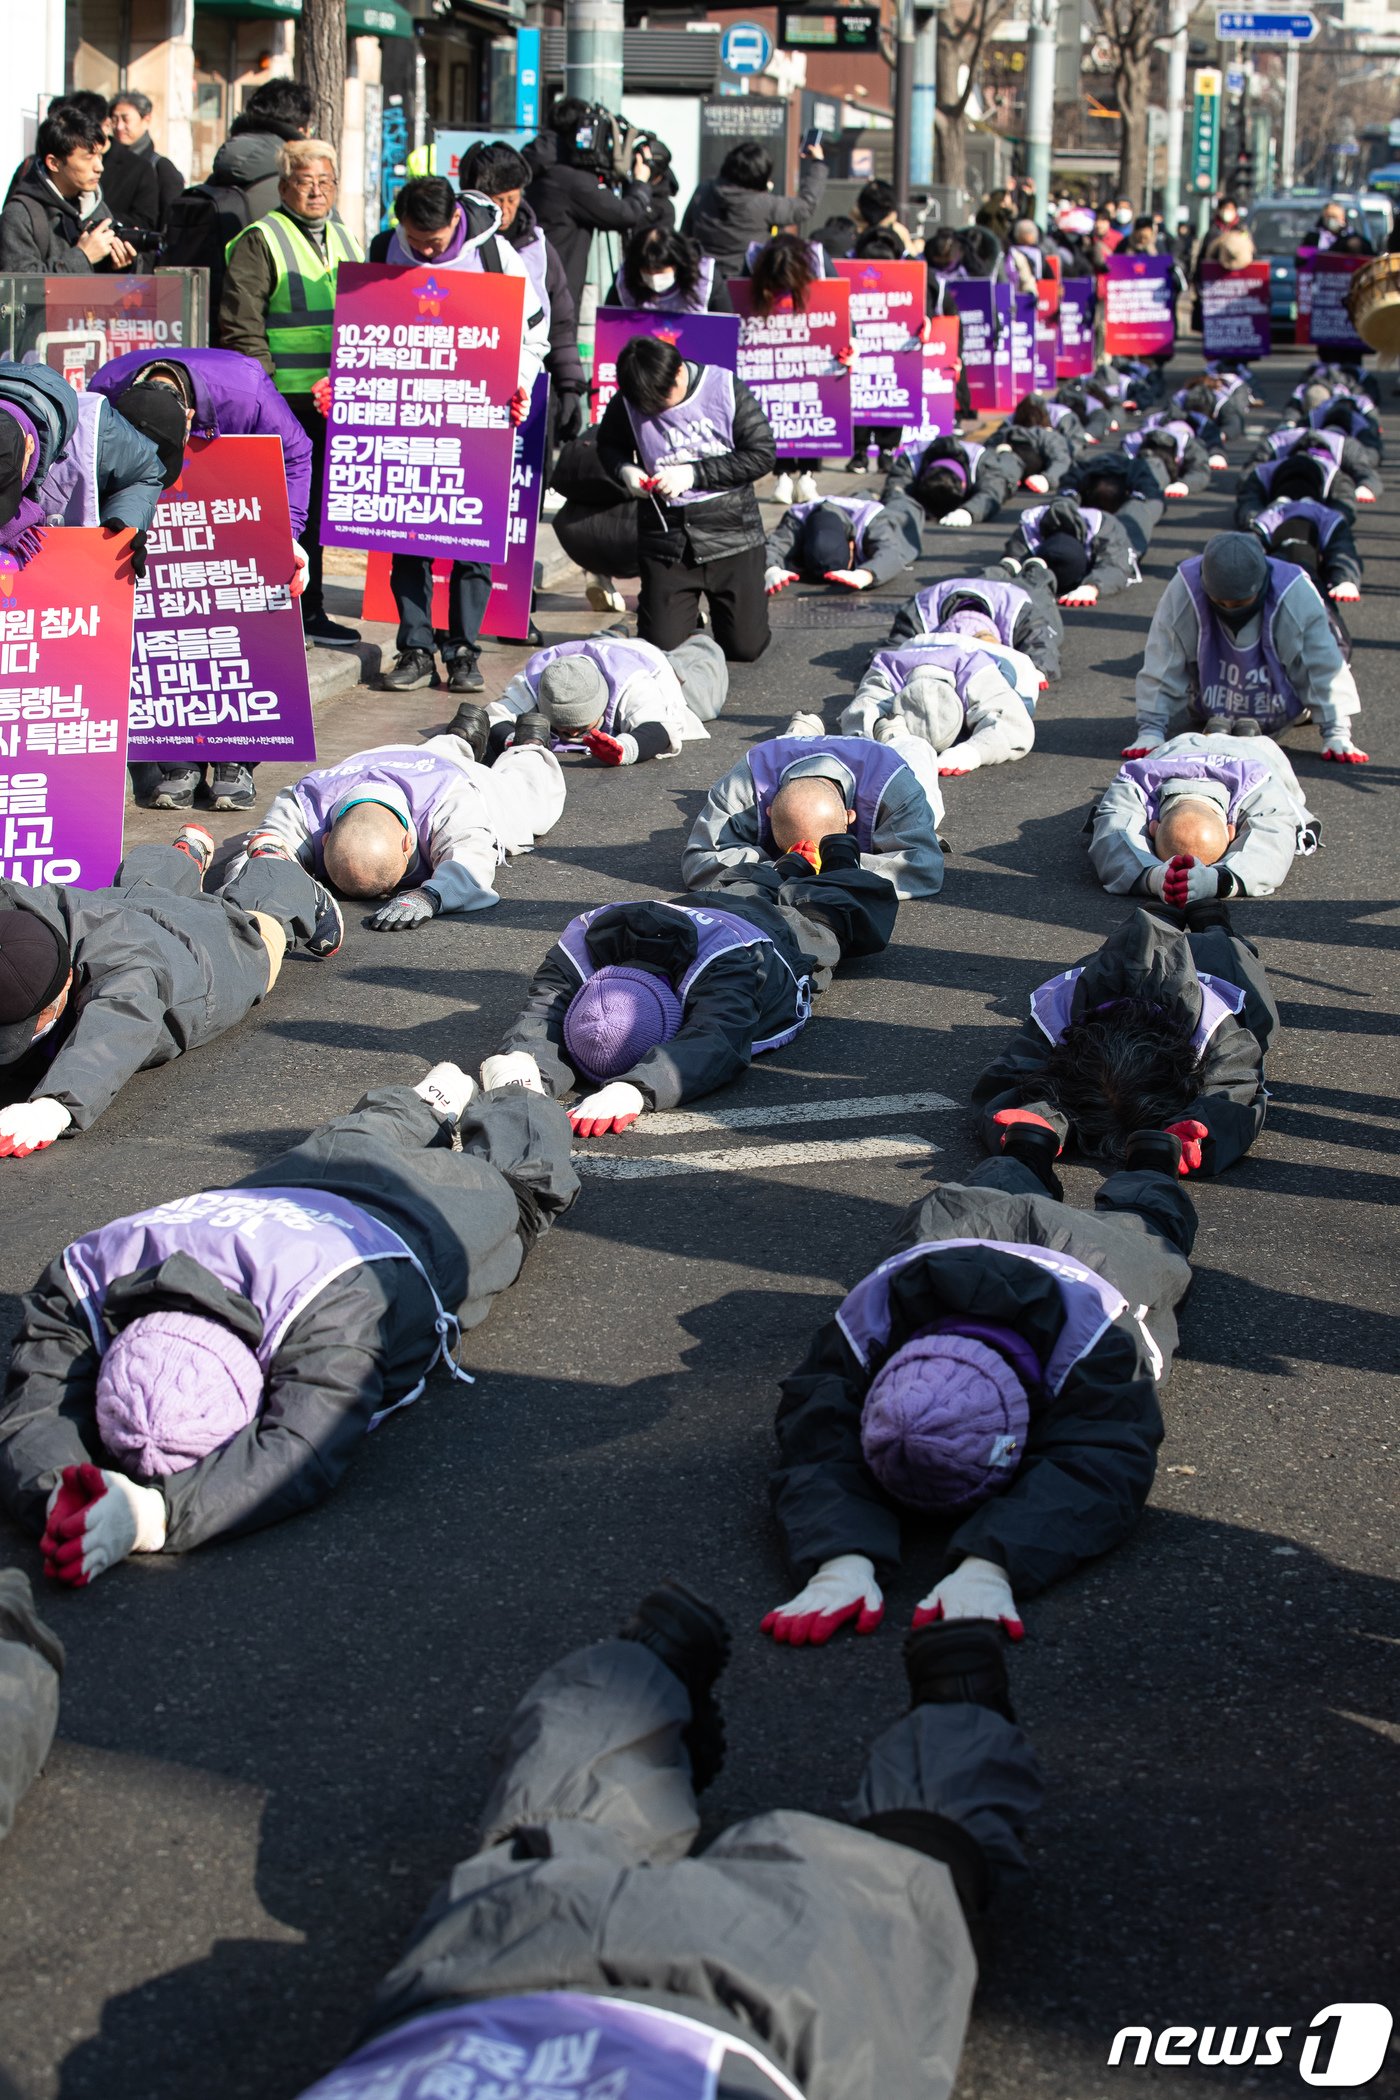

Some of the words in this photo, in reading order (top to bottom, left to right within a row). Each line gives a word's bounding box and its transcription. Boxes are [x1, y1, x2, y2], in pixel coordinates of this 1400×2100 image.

[337, 324, 391, 347] 10.29
[392, 325, 455, 349] 이태원
[457, 326, 500, 350] 참사
[335, 346, 458, 371] 유가족입니다
[333, 376, 398, 402] 윤석열
[400, 378, 491, 406] 대통령님,
[332, 402, 396, 427] 이태원
[399, 403, 444, 428] 참사
[445, 405, 511, 430] 특별법
[330, 435, 462, 467] 유가족들을
[328, 464, 382, 494] 먼저
[386, 465, 465, 496] 만나고
[210, 496, 262, 525] 참사
[326, 492, 484, 526] 결정하십시오
[154, 557, 265, 590] 대통령님,
[158, 589, 211, 618] 참사
[214, 583, 293, 614] 특별법
[40, 605, 101, 641] 참사
[156, 658, 253, 695] 만나고
[1202, 685, 1249, 713] 이태원
[26, 719, 119, 756] 특별법
